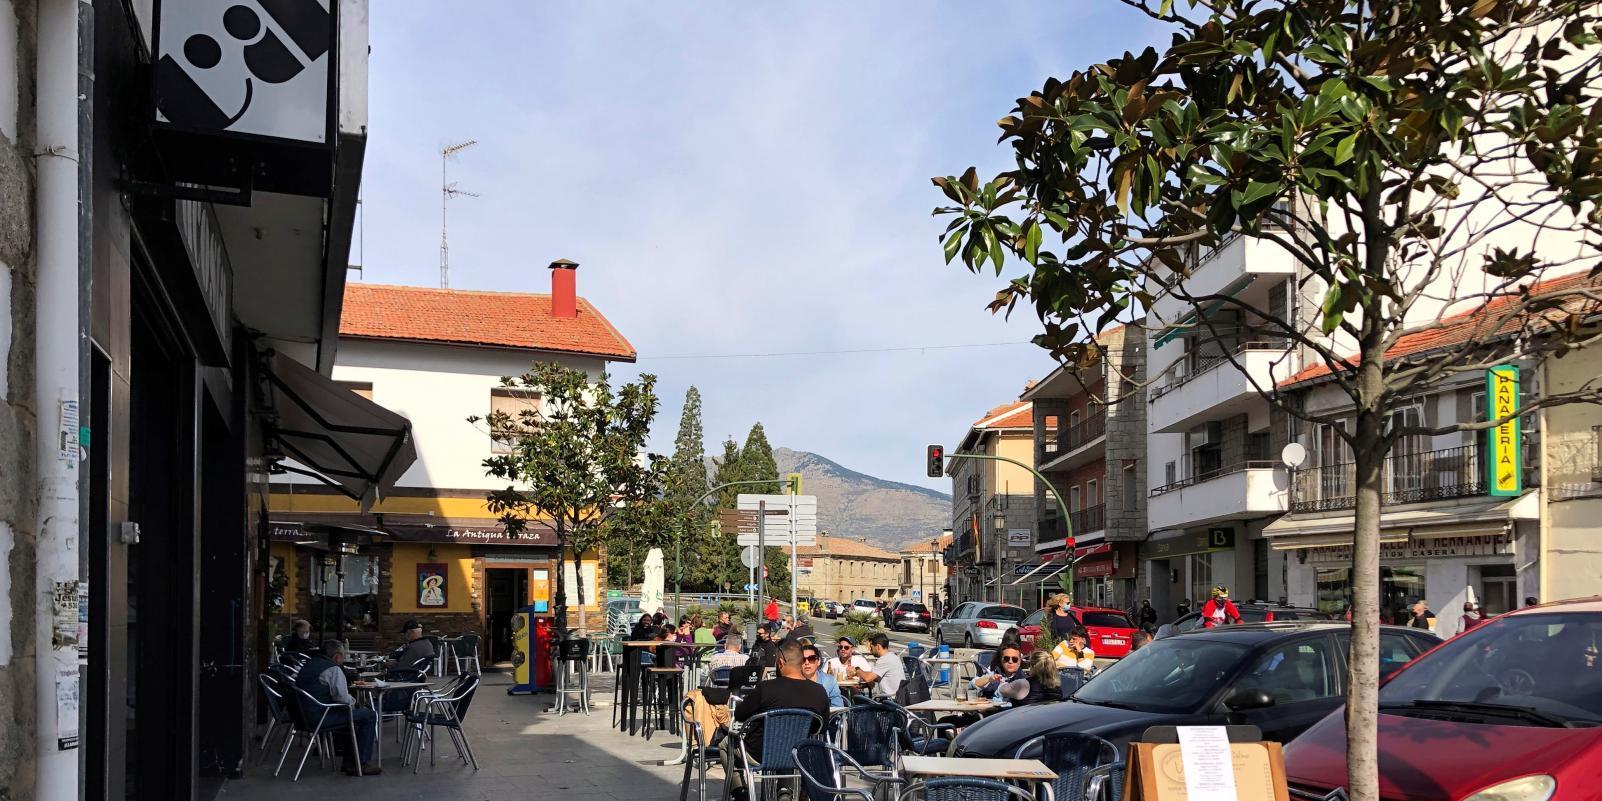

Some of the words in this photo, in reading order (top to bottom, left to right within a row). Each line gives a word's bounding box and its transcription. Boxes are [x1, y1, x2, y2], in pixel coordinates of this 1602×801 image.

[445, 529, 460, 538] La
[462, 529, 503, 543] Antigua
[505, 531, 541, 540] traza
[55, 593, 79, 604] Jesu
